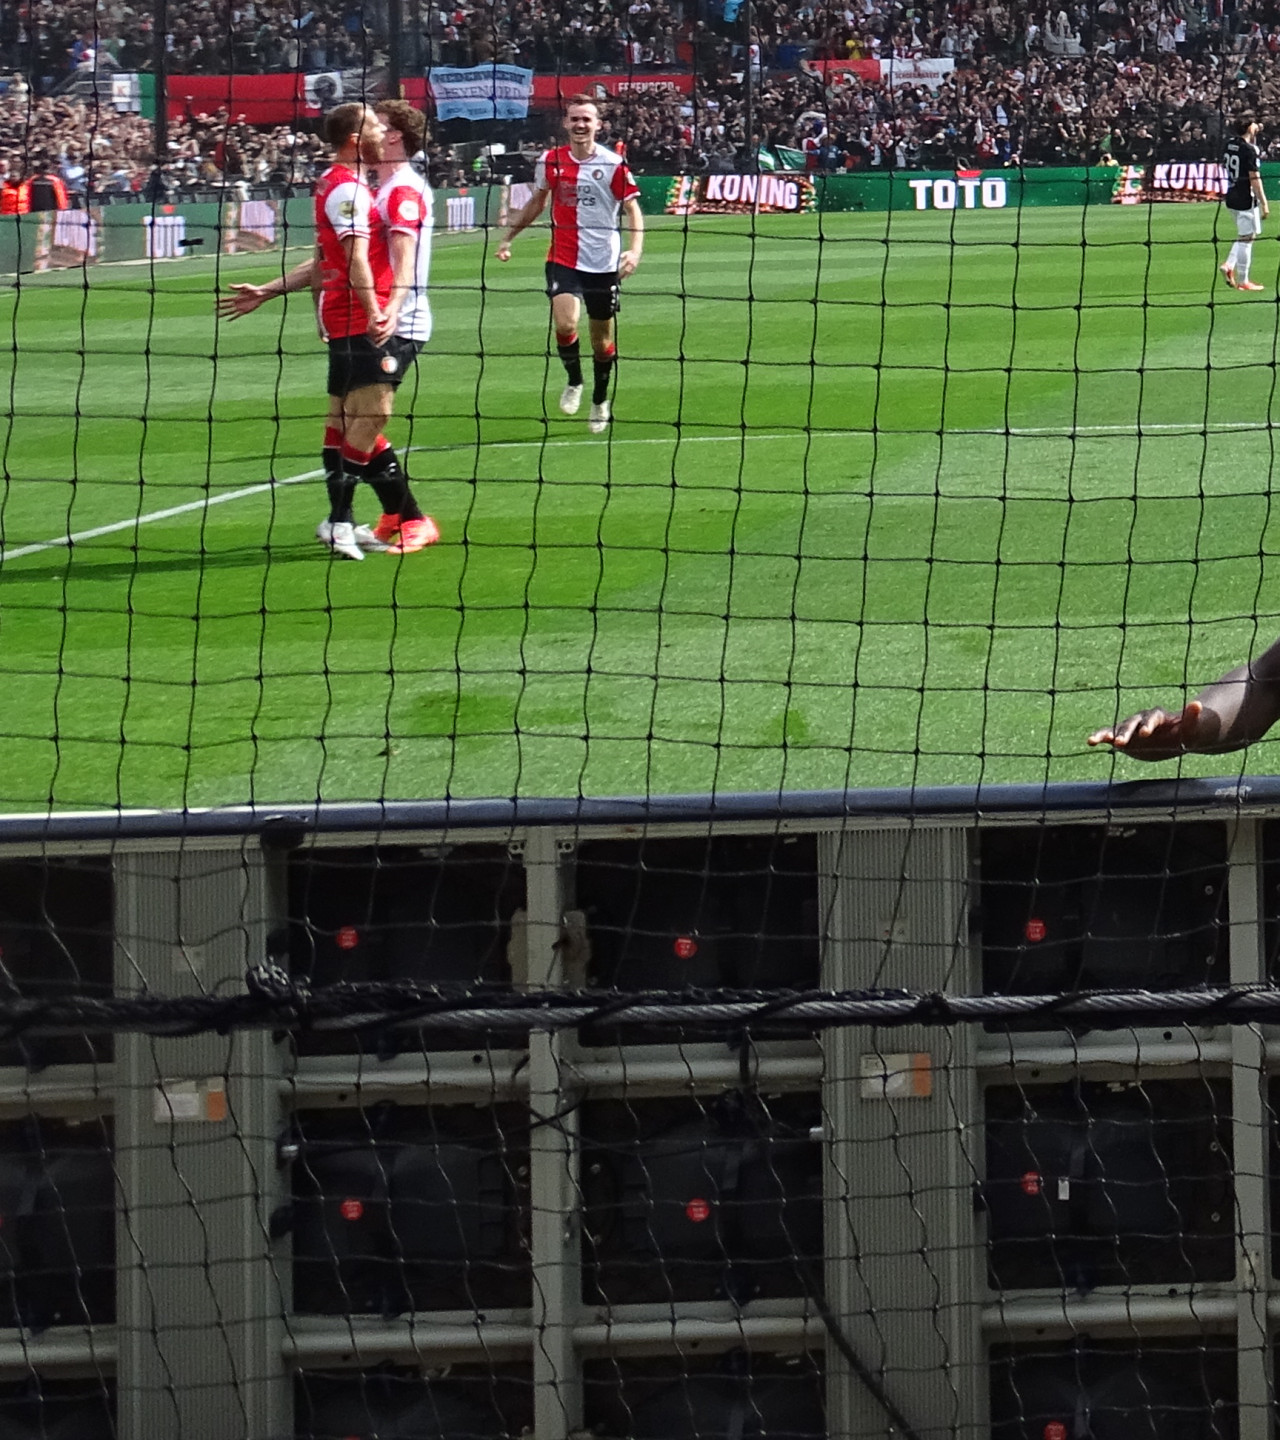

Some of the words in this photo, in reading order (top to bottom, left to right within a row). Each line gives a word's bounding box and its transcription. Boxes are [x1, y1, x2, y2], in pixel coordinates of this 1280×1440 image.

[706, 175, 799, 209] KONING
[909, 178, 1007, 210] TOTO
[1153, 163, 1229, 195] KONIN
